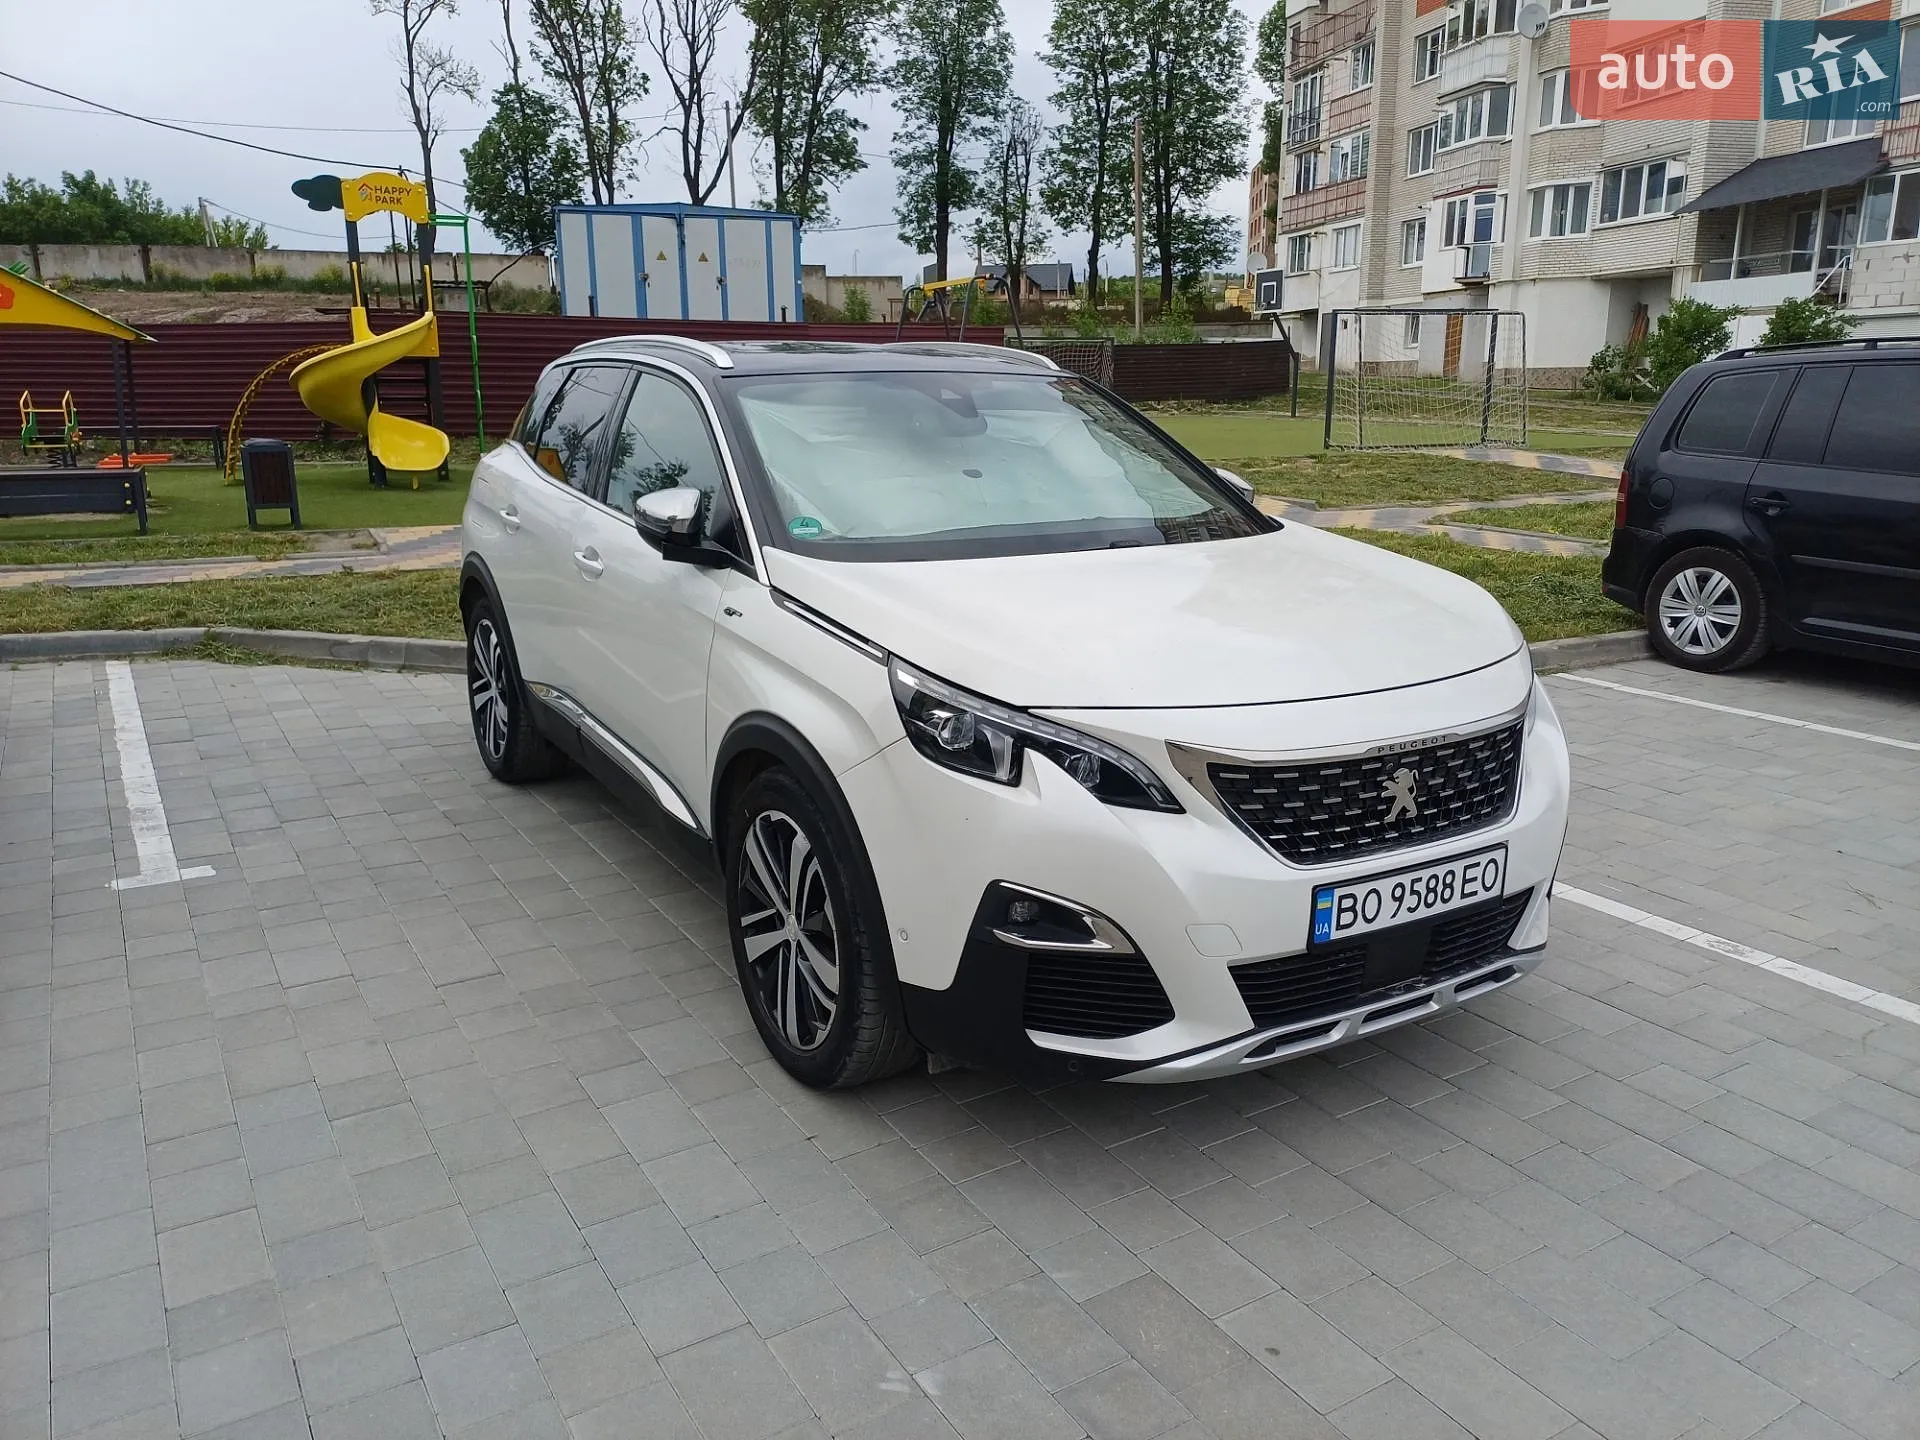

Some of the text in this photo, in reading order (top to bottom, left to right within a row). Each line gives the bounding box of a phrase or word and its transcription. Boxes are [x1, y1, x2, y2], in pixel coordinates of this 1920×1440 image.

[374, 185, 412, 196] HAPPY
[375, 195, 402, 205] PARK
[1377, 735, 1447, 754] PEUGEOT
[1335, 857, 1499, 931] BO 9588 EO
[1315, 923, 1329, 935] UA
